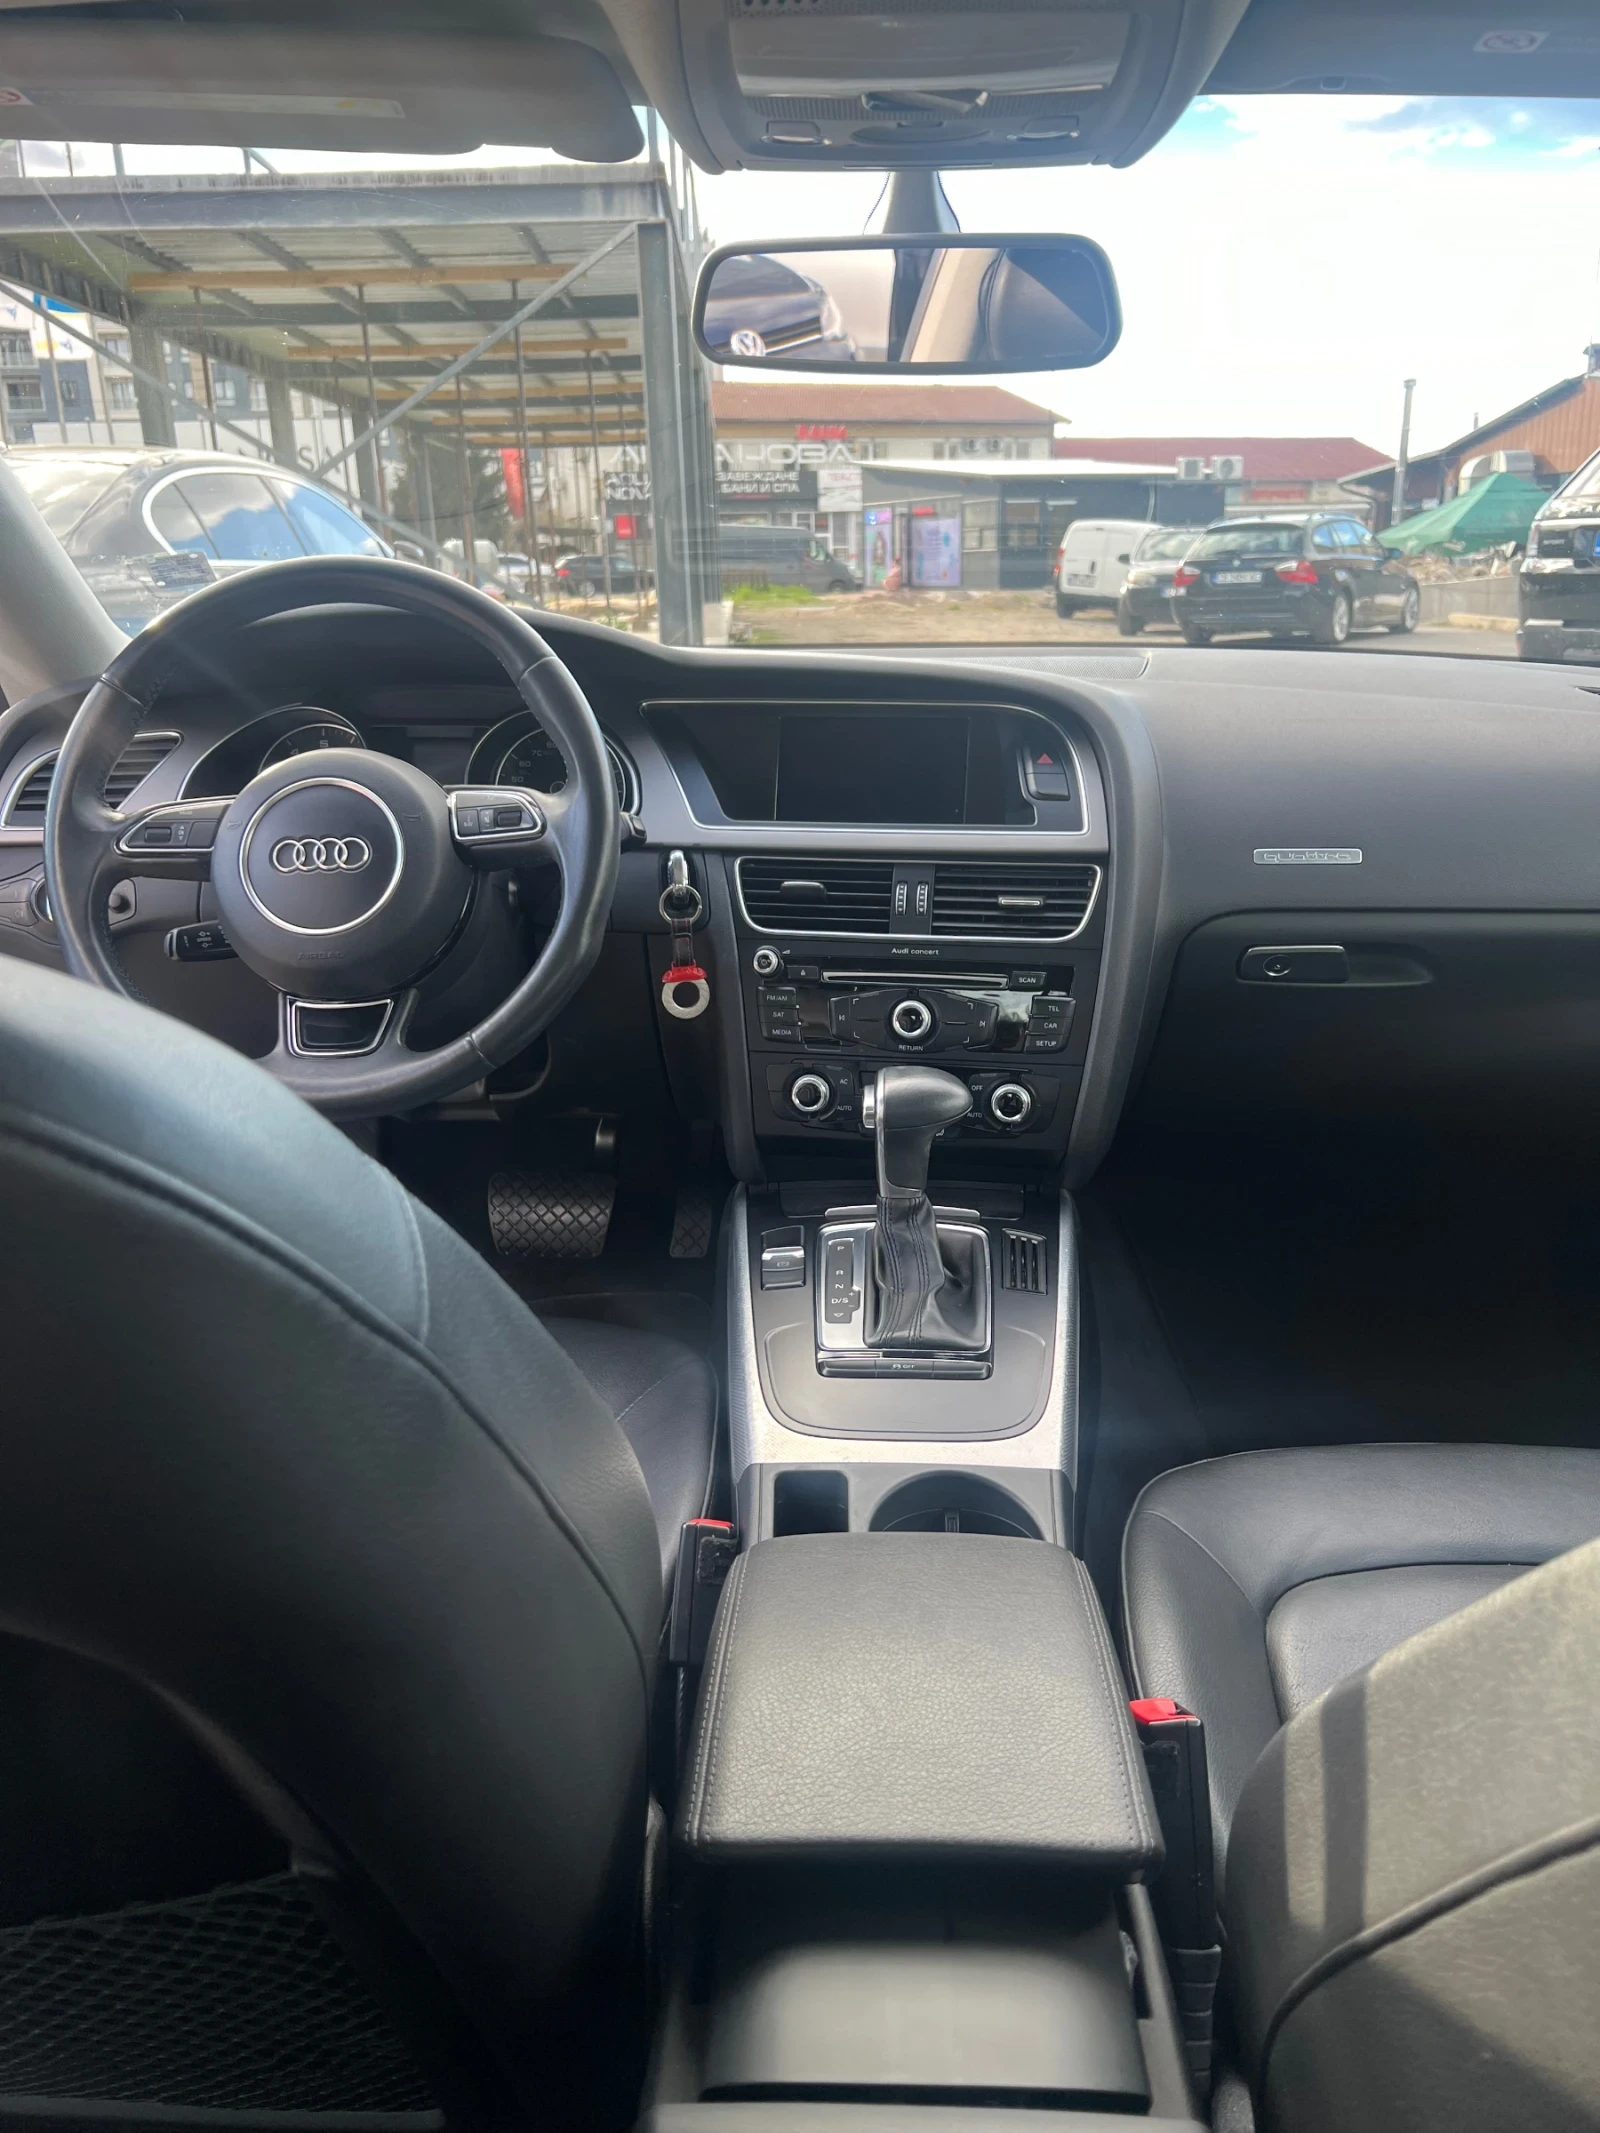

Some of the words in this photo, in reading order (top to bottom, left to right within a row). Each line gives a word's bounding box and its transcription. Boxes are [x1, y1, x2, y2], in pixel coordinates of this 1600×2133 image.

[605, 472, 650, 486] AQU
[715, 471, 800, 481] ЗАВЕЖДАНЕ
[606, 485, 652, 500] NOV
[319, 740, 329, 748] 5
[1263, 851, 1352, 863] quattro
[891, 947, 909, 955] Audi
[910, 948, 939, 956] concert
[1018, 976, 1037, 984] SCAN
[766, 994, 788, 1002] FM/AM
[1047, 1005, 1060, 1013] TEL
[1043, 1022, 1058, 1030] CAR
[771, 1028, 792, 1036] MEDIA
[1035, 1039, 1057, 1047] SETUP
[898, 1044, 924, 1052] RETURN
[971, 1084, 983, 1092] OFF
[836, 1104, 853, 1112] AUTO
[966, 1111, 983, 1119] AUTO
